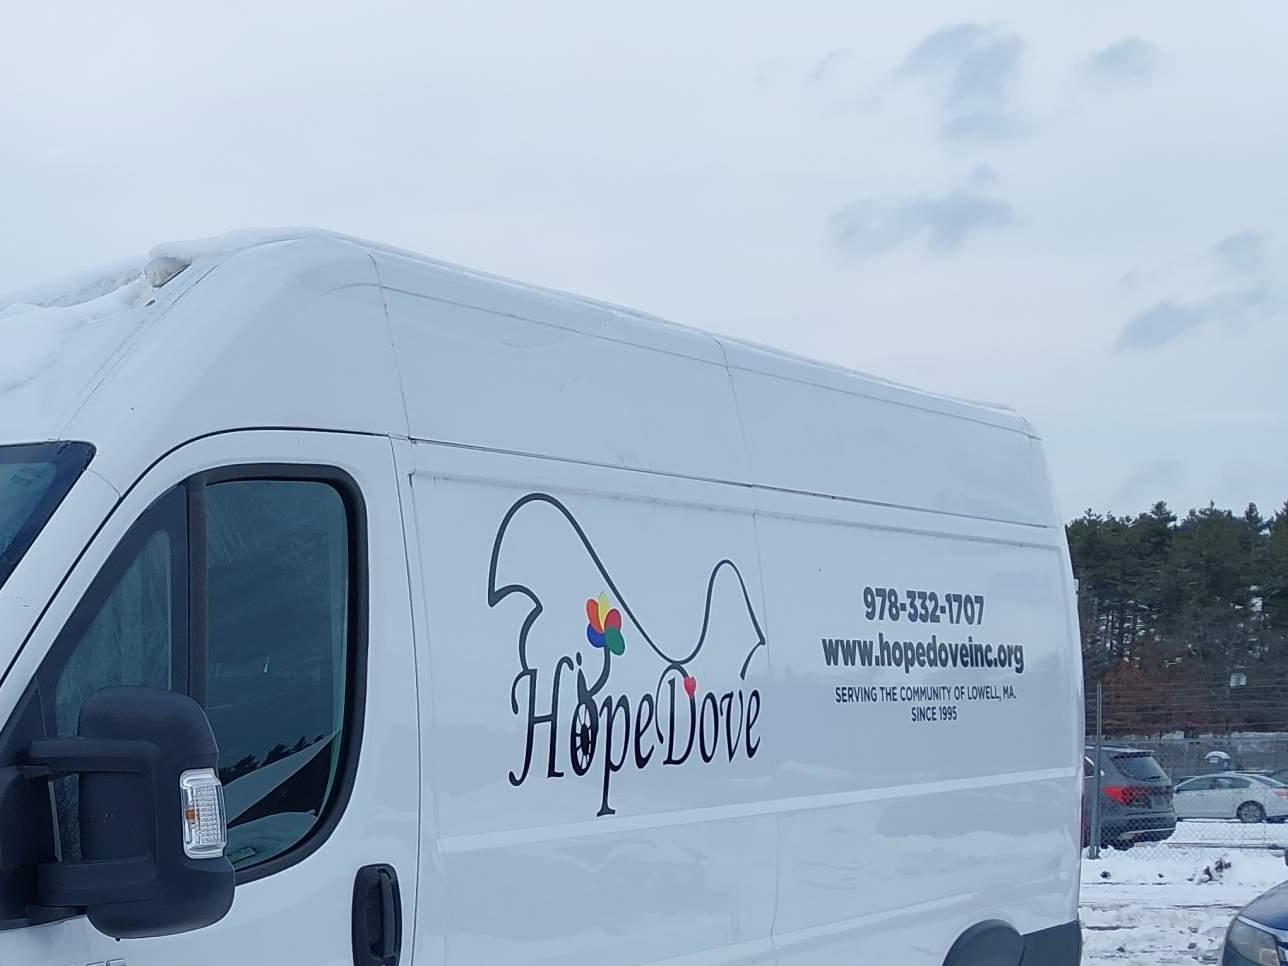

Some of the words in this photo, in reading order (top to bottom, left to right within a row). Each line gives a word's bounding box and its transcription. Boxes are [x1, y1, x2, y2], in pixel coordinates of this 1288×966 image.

[863, 586, 985, 625] 978-332-1707
[821, 632, 1025, 674] www.hopedoveinc.org
[835, 686, 878, 703] SERVING
[880, 686, 897, 702] THE
[899, 685, 951, 702] COMMUNITY
[953, 685, 965, 701] OF
[967, 685, 1002, 702] LOWELL,
[1003, 685, 1017, 699] MA.
[911, 706, 937, 722] SINCE
[939, 705, 958, 721] 1995
